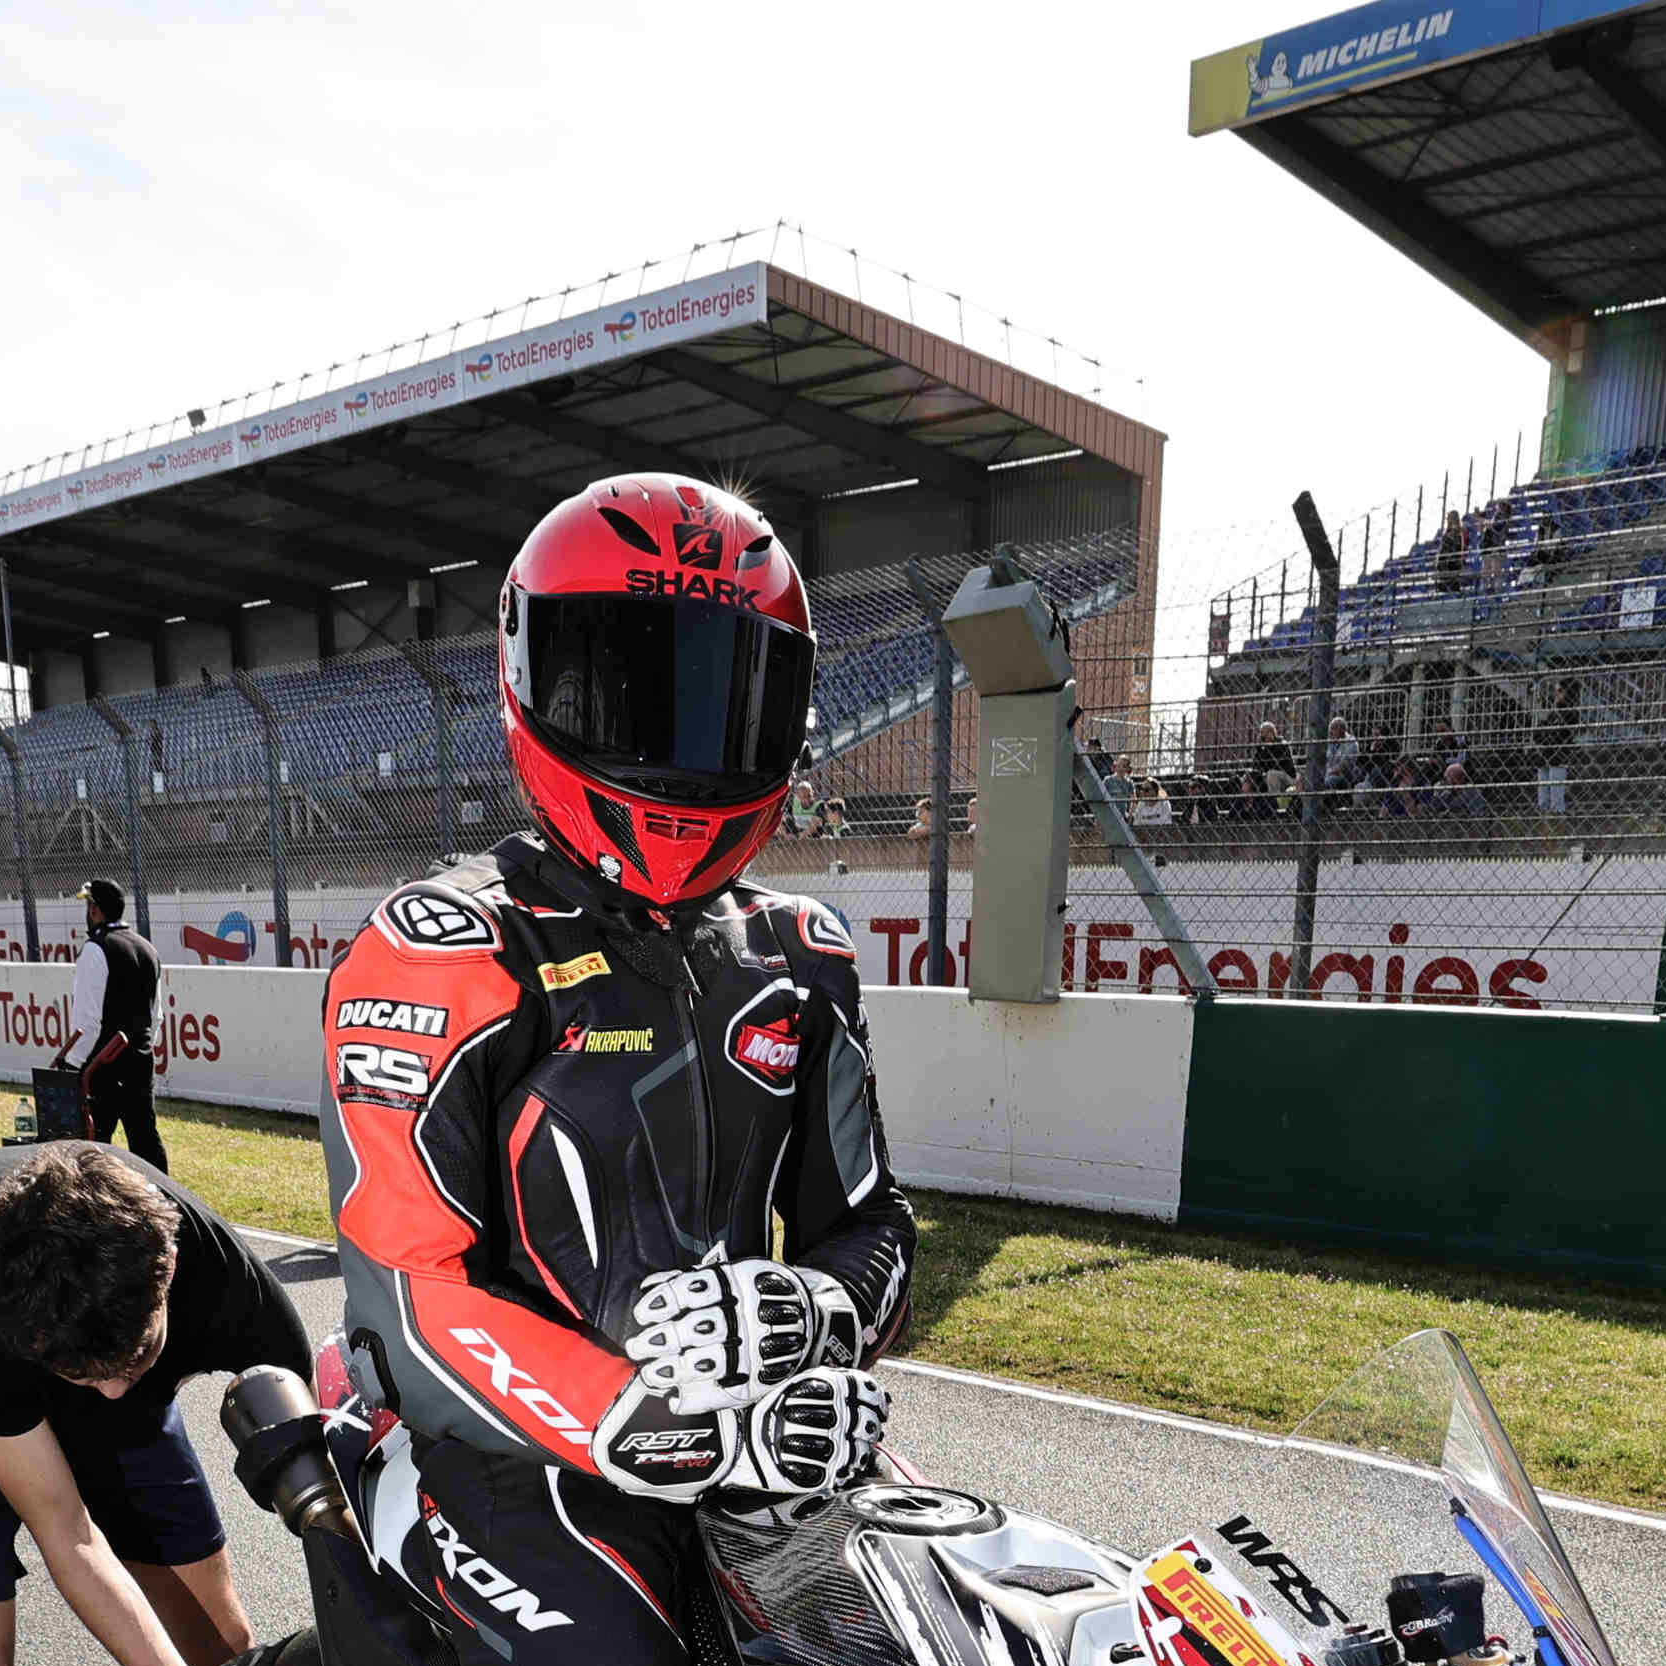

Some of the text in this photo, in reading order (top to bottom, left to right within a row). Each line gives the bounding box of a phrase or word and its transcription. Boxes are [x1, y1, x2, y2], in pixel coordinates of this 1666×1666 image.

[1296, 9, 1454, 80] MICHELIN
[640, 285, 755, 332] TotalEnergies
[495, 328, 594, 373] TotalEnergies
[370, 372, 456, 411] TotalEnergies
[262, 408, 338, 444] TotalEnergies
[166, 440, 233, 473] TotalEnergies
[83, 468, 143, 498] TotalEnergies
[625, 568, 761, 612] SHARK
[869, 918, 1549, 1009] TotlEnergies
[336, 1000, 448, 1037] DUCATI
[584, 1027, 654, 1053] AKRAPOVIČ
[743, 1033, 800, 1068] MOT
[337, 1043, 429, 1095] RS
[616, 1428, 714, 1452] RST
[1215, 1514, 1351, 1628] WRS
